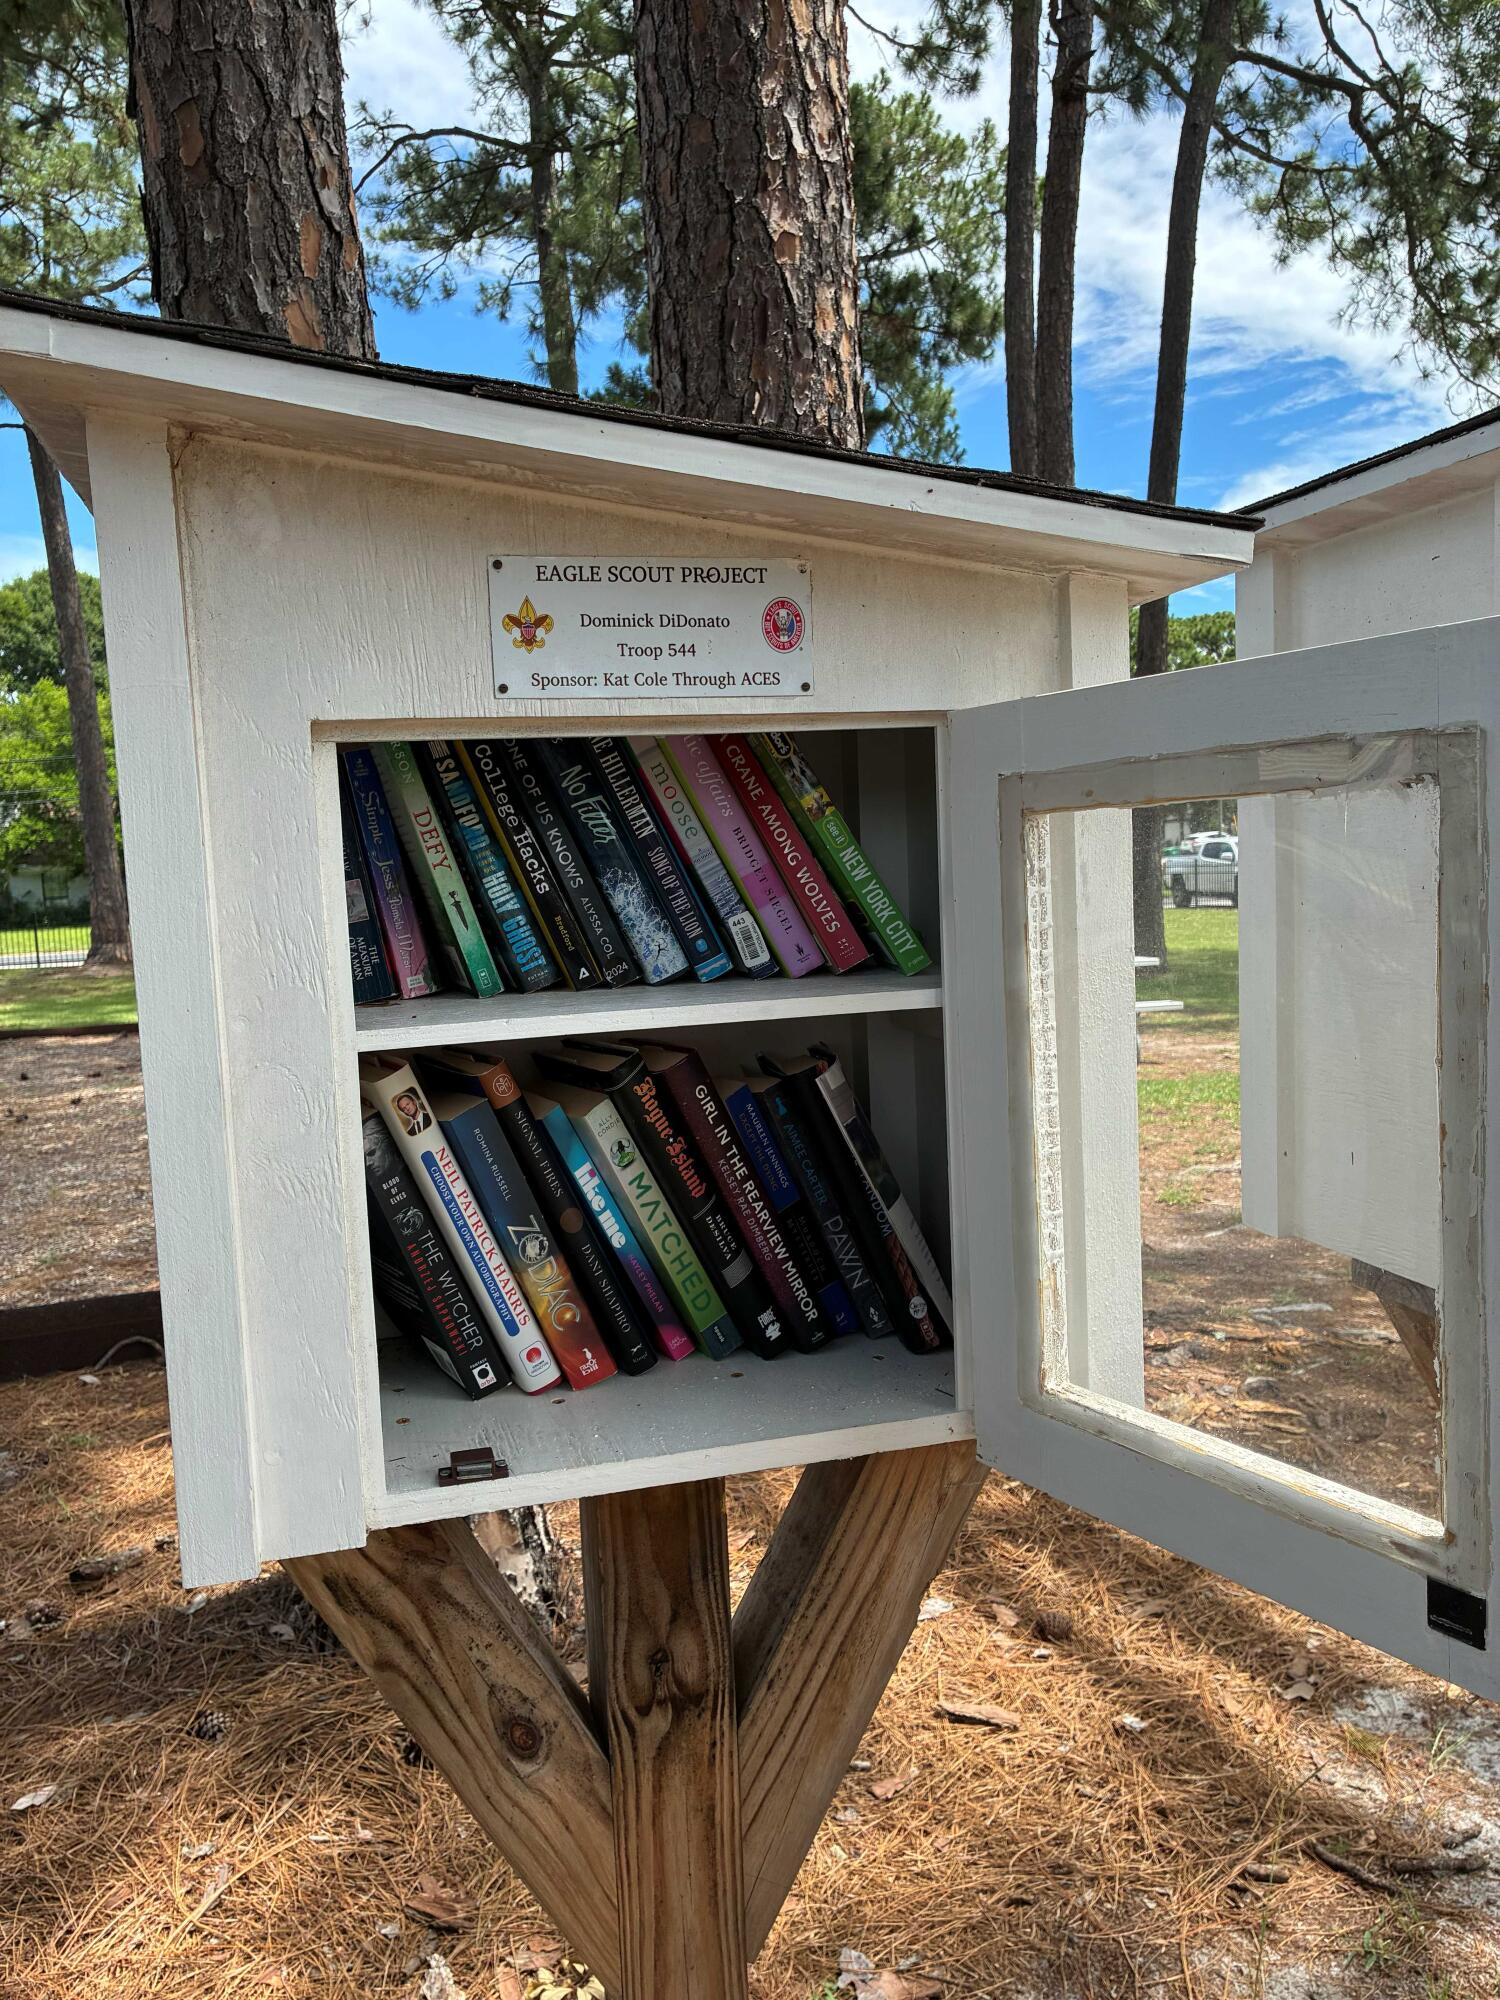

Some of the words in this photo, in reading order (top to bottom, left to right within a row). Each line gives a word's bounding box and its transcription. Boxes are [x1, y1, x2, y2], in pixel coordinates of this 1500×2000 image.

[536, 565, 602, 583] EAGLE
[607, 566, 674, 583] SCOUT
[681, 566, 768, 584] PROJECT
[579, 613, 655, 629] Dominick
[659, 613, 730, 629] DiDonato
[617, 643, 663, 658] Troop
[668, 643, 696, 656] 544
[531, 672, 597, 688] Sponsor:
[603, 673, 629, 686] Kat
[633, 672, 667, 686] Cole
[673, 672, 735, 687] Through
[741, 672, 780, 686] ACES
[436, 758, 491, 851] SANDFORD
[560, 764, 592, 796] No
[600, 751, 657, 839] HILLERMAN
[650, 762, 698, 840] moose
[696, 760, 734, 817] affairs
[356, 790, 385, 846] Simple
[412, 806, 452, 871] DEFY
[475, 744, 519, 828] College
[513, 830, 551, 895] Hacks
[522, 774, 543, 798] OF
[535, 801, 554, 825] US
[546, 828, 584, 889] KNOWS
[570, 794, 617, 849] Filter
[726, 745, 765, 801] CRANE
[758, 805, 801, 867] AMONG
[796, 866, 841, 934] WOLVES
[826, 822, 839, 837] see
[834, 836, 846, 845] it
[368, 858, 395, 890] Jess
[647, 846, 673, 876] SONG
[661, 874, 680, 891] OF
[732, 827, 768, 884] BRIDGET
[765, 887, 793, 936] SIEGEL
[482, 870, 520, 914] HOLY
[502, 914, 547, 973] GHOST
[581, 897, 604, 936] ALYSSA
[668, 888, 691, 914] THE
[679, 911, 704, 940] LION
[732, 918, 746, 928] 443
[839, 845, 872, 882] NEW
[862, 879, 897, 924] YORK
[885, 920, 918, 954] CITY
[356, 936, 373, 977] MEASURE
[369, 944, 380, 965] THE
[554, 914, 576, 952] Bradford
[606, 962, 628, 979] 2024
[473, 1128, 494, 1164] ROMINA
[491, 1164, 512, 1201] RUSSELL
[514, 1110, 543, 1158] SIGNAL
[540, 1160, 565, 1198] FIRES
[632, 1075, 674, 1140] Rogue
[665, 1136, 707, 1199] Island
[745, 1103, 769, 1146] MAUREEN
[764, 1146, 789, 1189] JENNINGS
[382, 1176, 401, 1190] BLOOD
[389, 1191, 407, 1205] ELVES
[390, 1186, 400, 1195] OF
[574, 1162, 606, 1212] like
[599, 1209, 627, 1249] me
[695, 1084, 719, 1125] GIRL
[714, 1123, 732, 1146] IN
[725, 1144, 749, 1181] THE
[742, 1179, 790, 1261] REARVIEW
[782, 1260, 819, 1323] MIRROR
[801, 1159, 828, 1205] CARTER
[435, 1145, 460, 1189] NEIL
[456, 1188, 499, 1262] PATRICK
[493, 1261, 532, 1327] HARRIS
[705, 1216, 732, 1260] DESILVA
[715, 1213, 737, 1250] BRUCE
[718, 1159, 741, 1195] KELSEY
[736, 1194, 751, 1218] RAE
[746, 1216, 773, 1262] DIMBERG
[430, 1166, 451, 1202] CHOOSE
[447, 1202, 465, 1230] YOUR
[460, 1226, 478, 1250] OWN
[471, 1248, 512, 1322] AUTOBIOGRAPHY
[628, 1171, 711, 1312] MATCHED
[823, 1214, 871, 1289] PAWN
[418, 1229, 444, 1267] THE
[437, 1270, 484, 1351] WITCHER
[506, 1214, 581, 1332] ZODIAC
[581, 1243, 603, 1278] DANI
[599, 1279, 632, 1334] SHAPIRO
[644, 1280, 665, 1313] PHELAN
[480, 1376, 496, 1388] orbit
